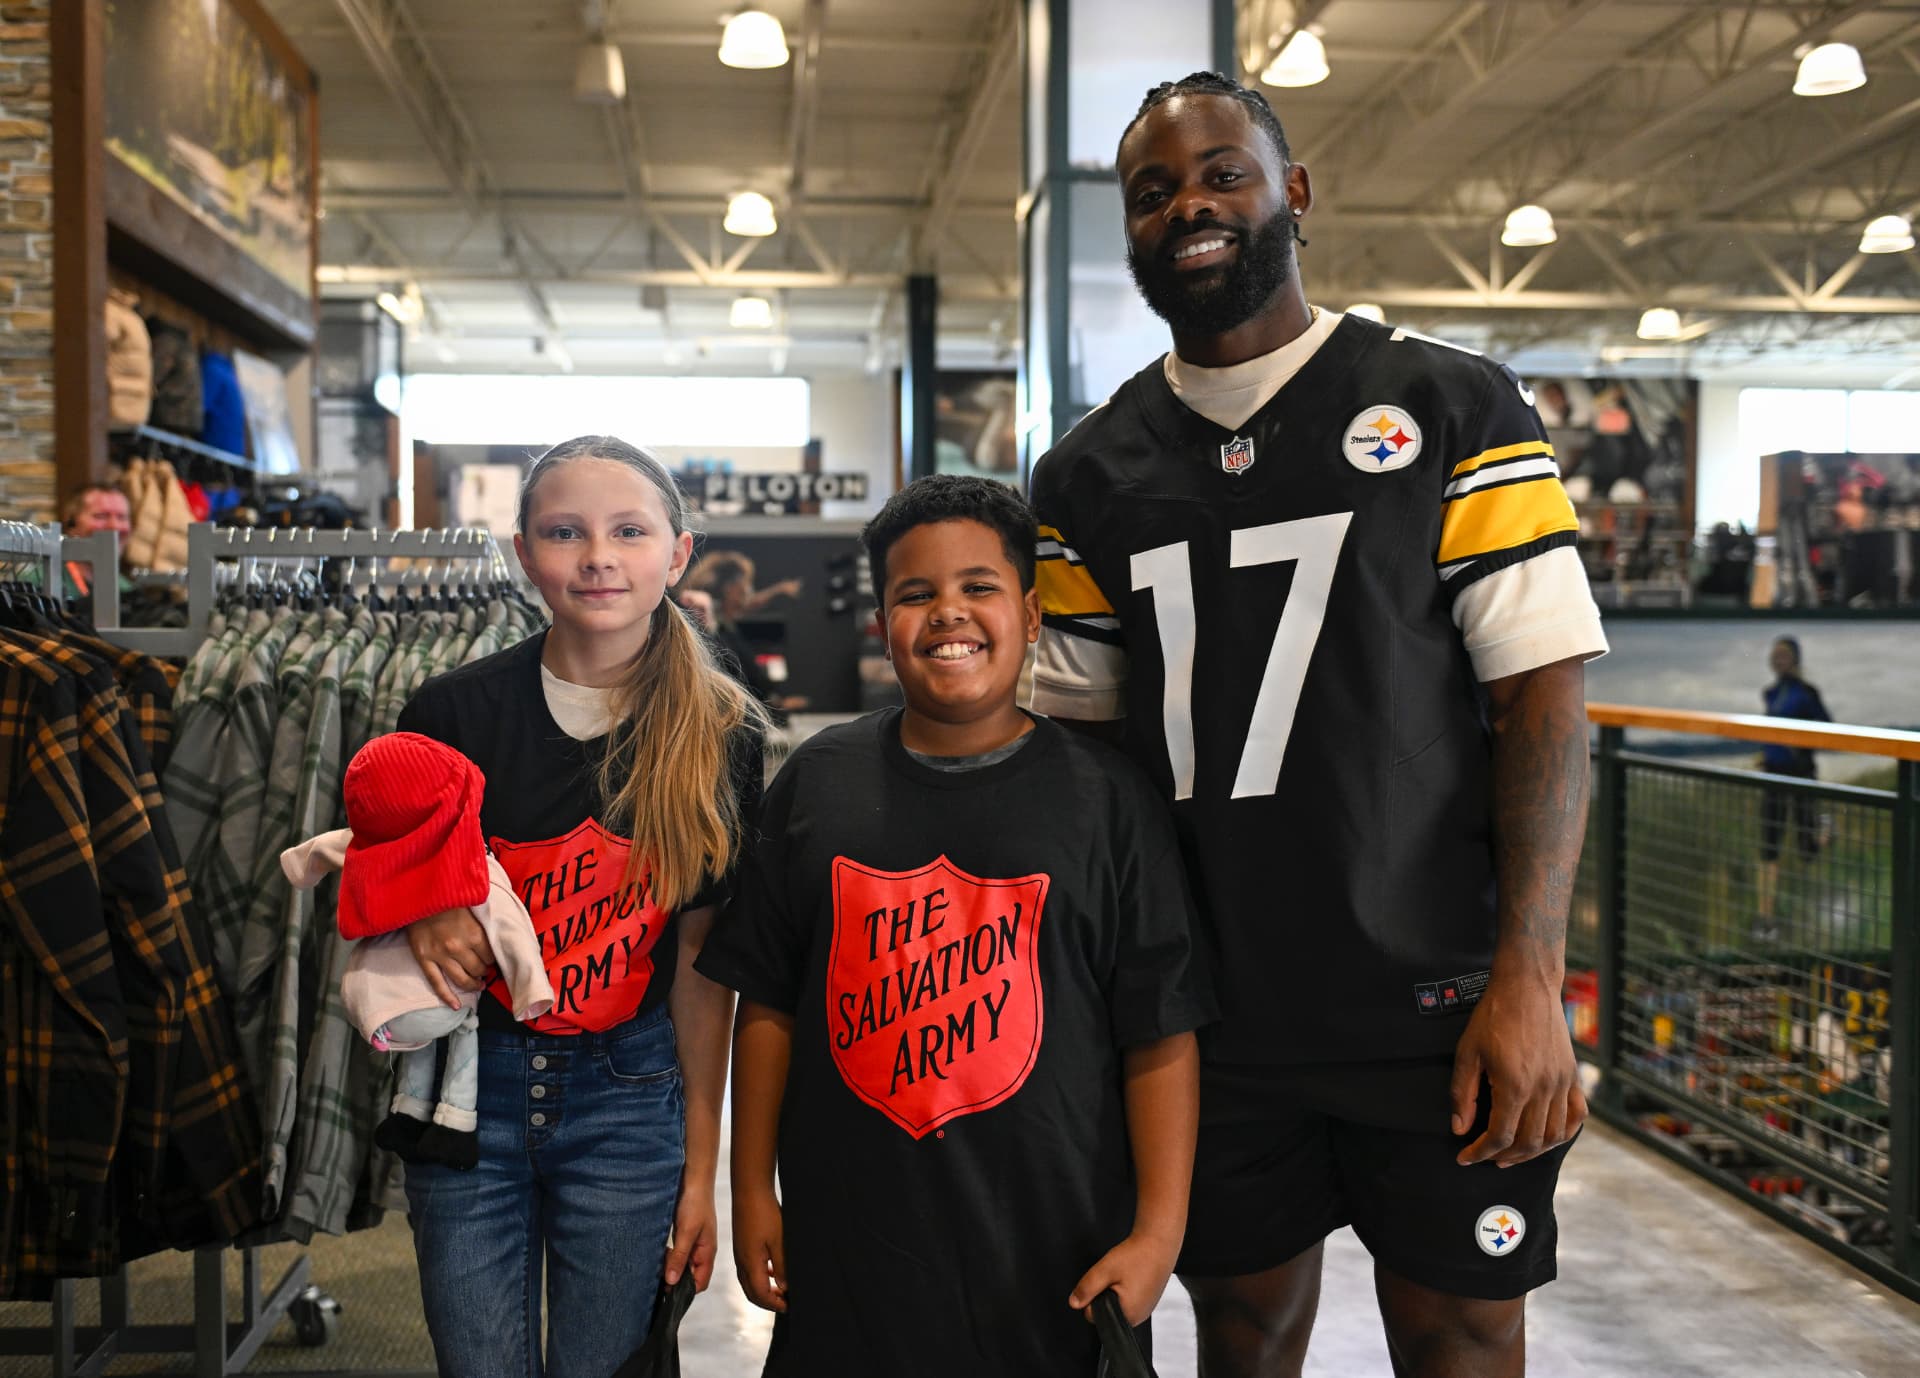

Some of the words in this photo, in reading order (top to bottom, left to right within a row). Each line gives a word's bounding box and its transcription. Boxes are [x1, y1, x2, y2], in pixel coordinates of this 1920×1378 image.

[1226, 450, 1249, 468] NFL
[1350, 433, 1381, 445] Steelers
[705, 473, 865, 501] PELOTON
[1129, 511, 1354, 801] 17
[520, 848, 600, 917] THE
[864, 887, 950, 962] THE
[544, 922, 649, 1016] RMY
[835, 901, 1023, 1050] SALVATION
[888, 979, 1011, 1097] ARMY
